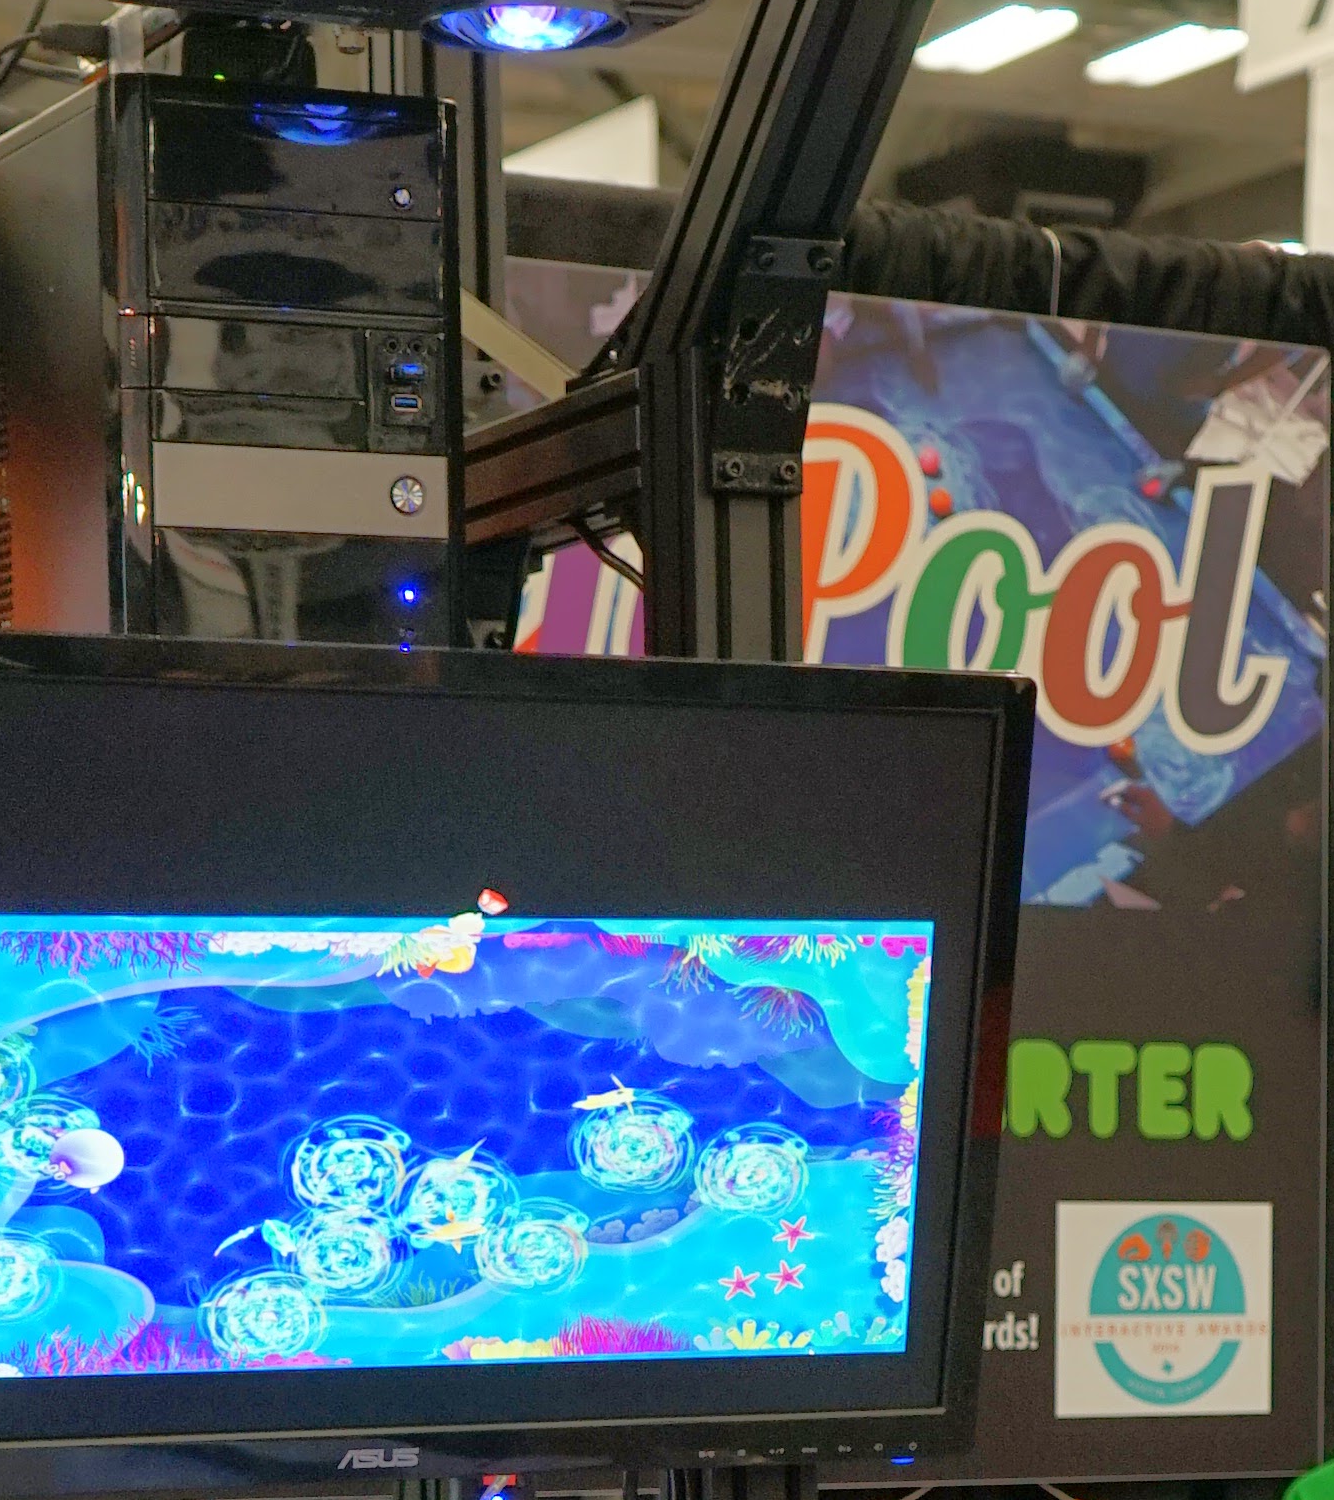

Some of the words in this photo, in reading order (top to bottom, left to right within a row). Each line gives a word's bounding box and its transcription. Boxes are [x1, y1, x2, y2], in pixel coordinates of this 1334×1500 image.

[1002, 1038, 1255, 1141] RTER
[993, 1260, 1025, 1297] of
[1118, 1263, 1217, 1311] SXSW
[982, 1311, 1040, 1351] rds!
[337, 1447, 419, 1469] ASUS
